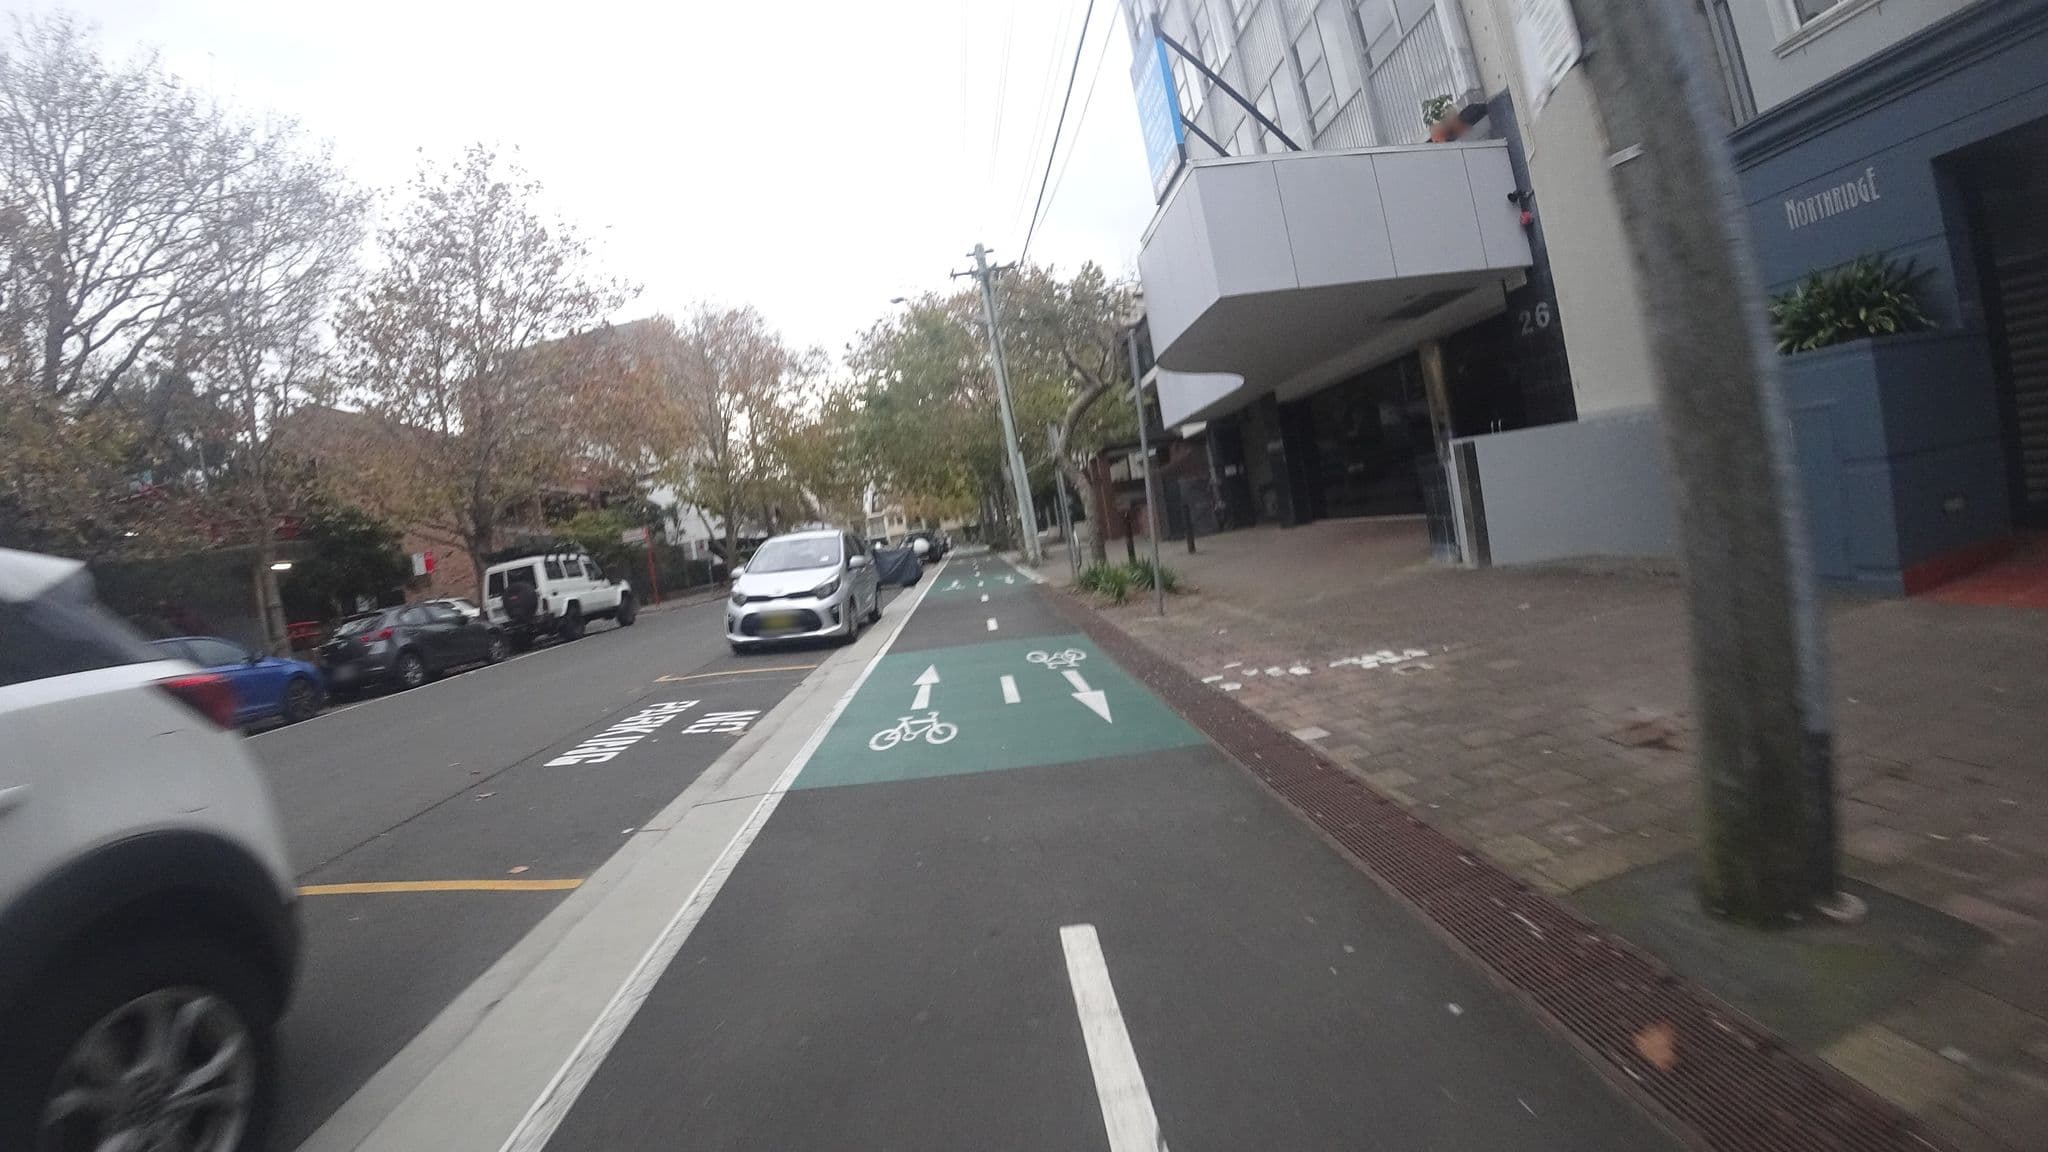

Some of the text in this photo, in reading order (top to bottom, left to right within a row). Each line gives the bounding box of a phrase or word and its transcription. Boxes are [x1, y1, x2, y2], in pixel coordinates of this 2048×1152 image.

[1784, 167, 1880, 230] NORTHRIDGE
[1518, 301, 1551, 336] 26
[543, 699, 701, 767] PARKING
[681, 709, 761, 736] NO
